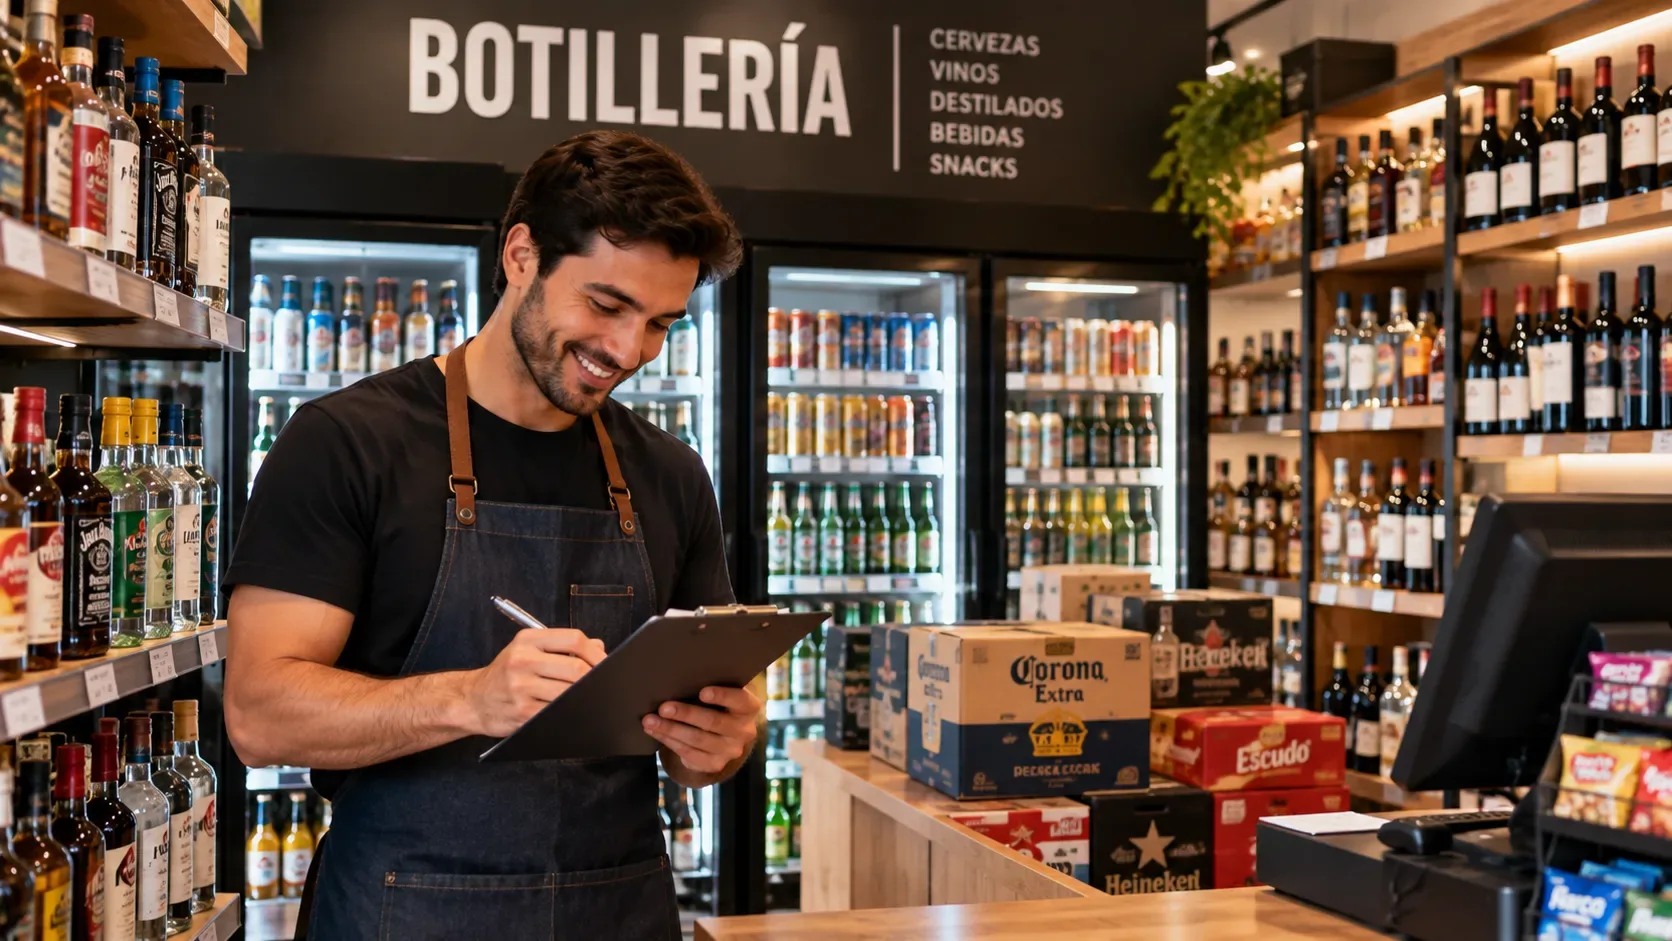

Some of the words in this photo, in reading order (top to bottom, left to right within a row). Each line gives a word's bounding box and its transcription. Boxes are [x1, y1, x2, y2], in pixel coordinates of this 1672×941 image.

[929, 28, 1041, 57] CERVEZAS
[409, 18, 853, 138] BOTILLERÍA
[929, 59, 1001, 85] VINOS
[929, 90, 1064, 119] DESTILADOS
[929, 121, 1025, 149] BEBIDAS
[929, 153, 1018, 180] SNACKS
[1035, 684, 1085, 704] Extra
[1236, 740, 1310, 774] Escudo
